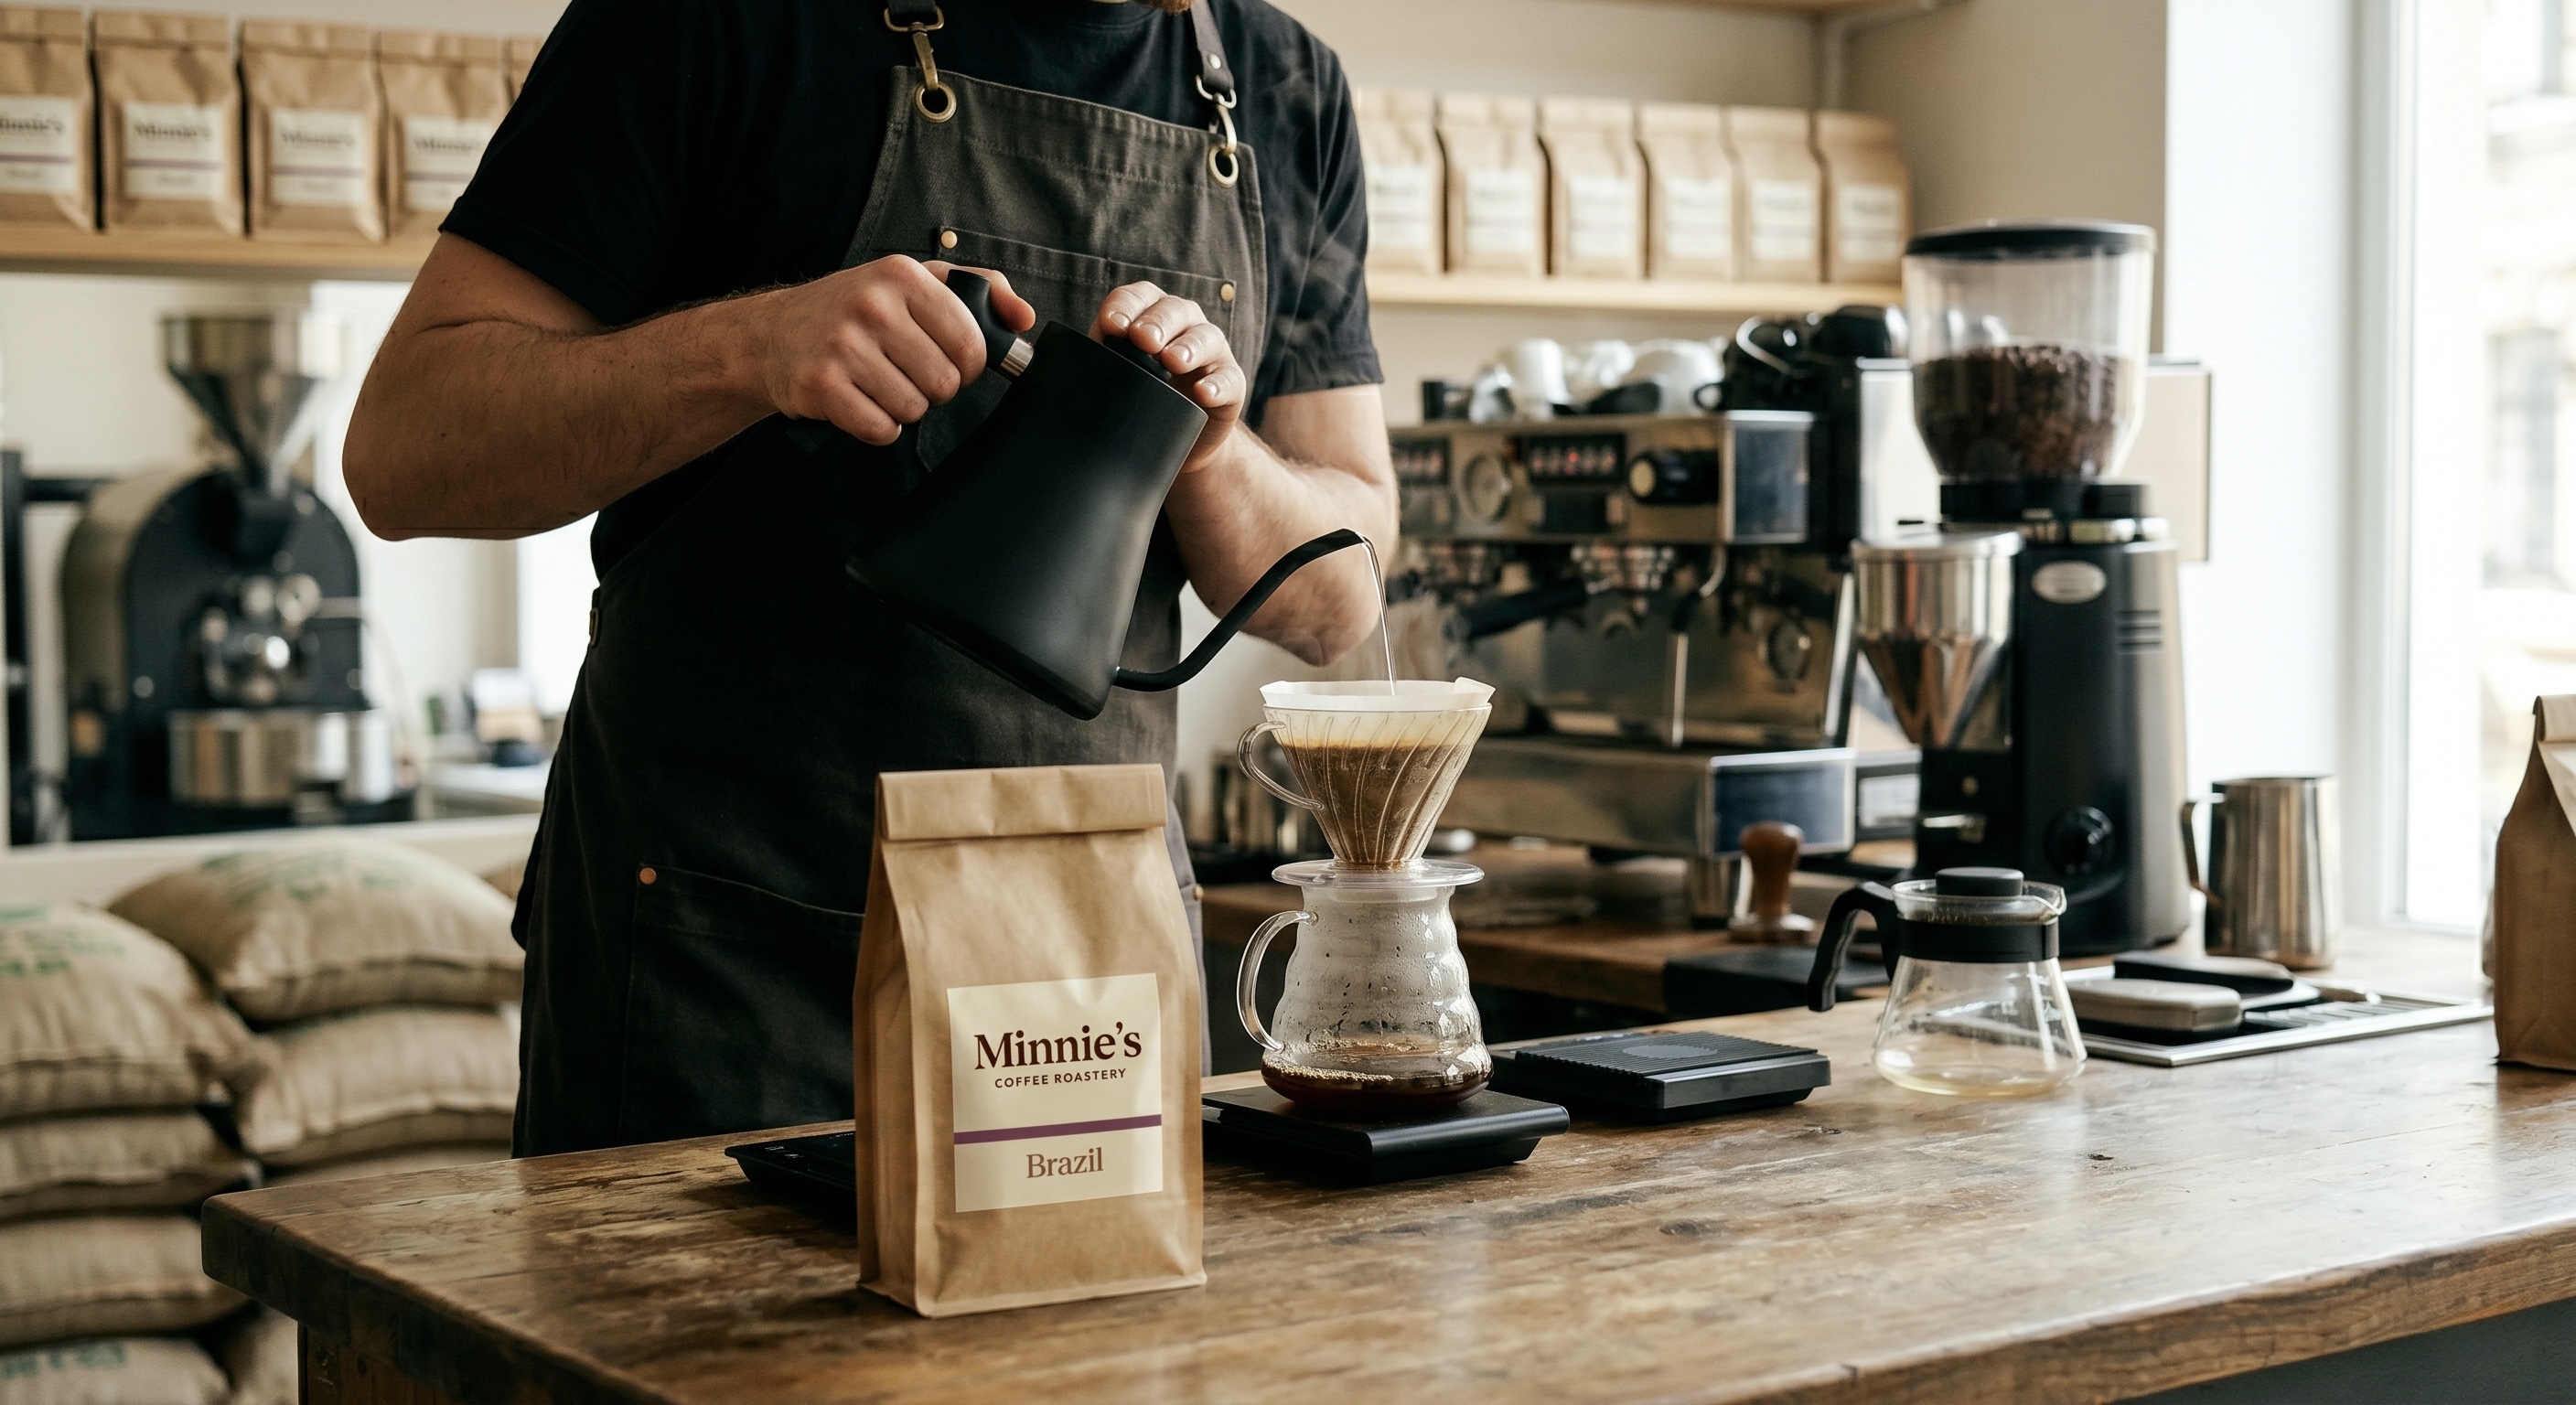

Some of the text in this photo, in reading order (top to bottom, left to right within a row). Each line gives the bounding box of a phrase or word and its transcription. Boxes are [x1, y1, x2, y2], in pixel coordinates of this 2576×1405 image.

[974, 1022, 1142, 1069] Minnie's
[994, 1068, 1126, 1088] COFFEE ROASTERY
[1026, 1147, 1104, 1178] Brazil
